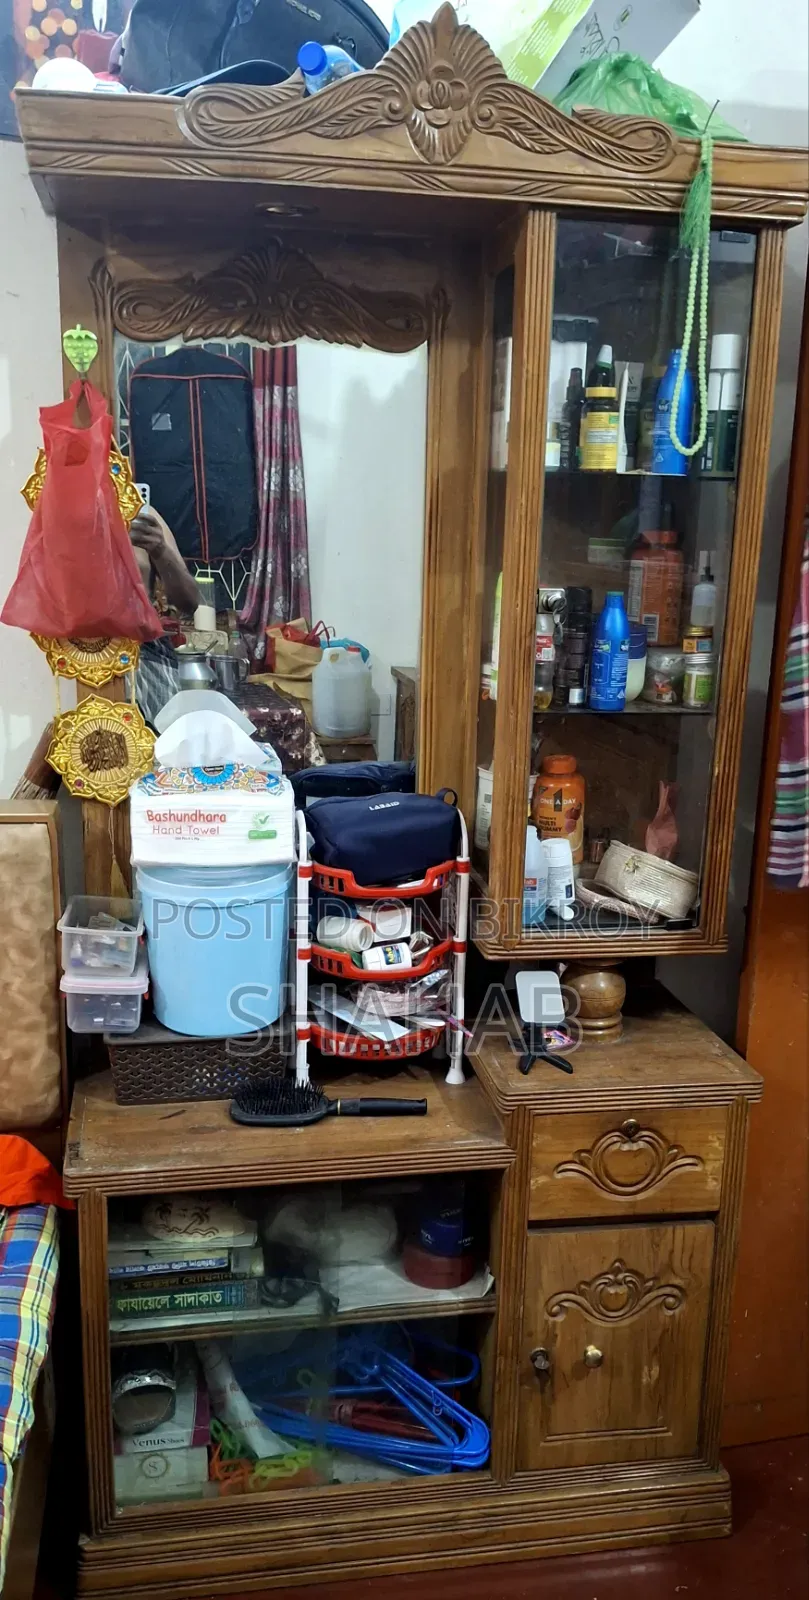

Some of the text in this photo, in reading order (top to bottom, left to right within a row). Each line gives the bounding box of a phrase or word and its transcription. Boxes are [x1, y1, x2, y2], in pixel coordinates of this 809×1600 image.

[146, 809, 227, 823] Bashundhara
[152, 824, 220, 836] Hand Towel
[174, 1290, 225, 1309] সাদাকাত
[132, 1437, 167, 1447] Venus
